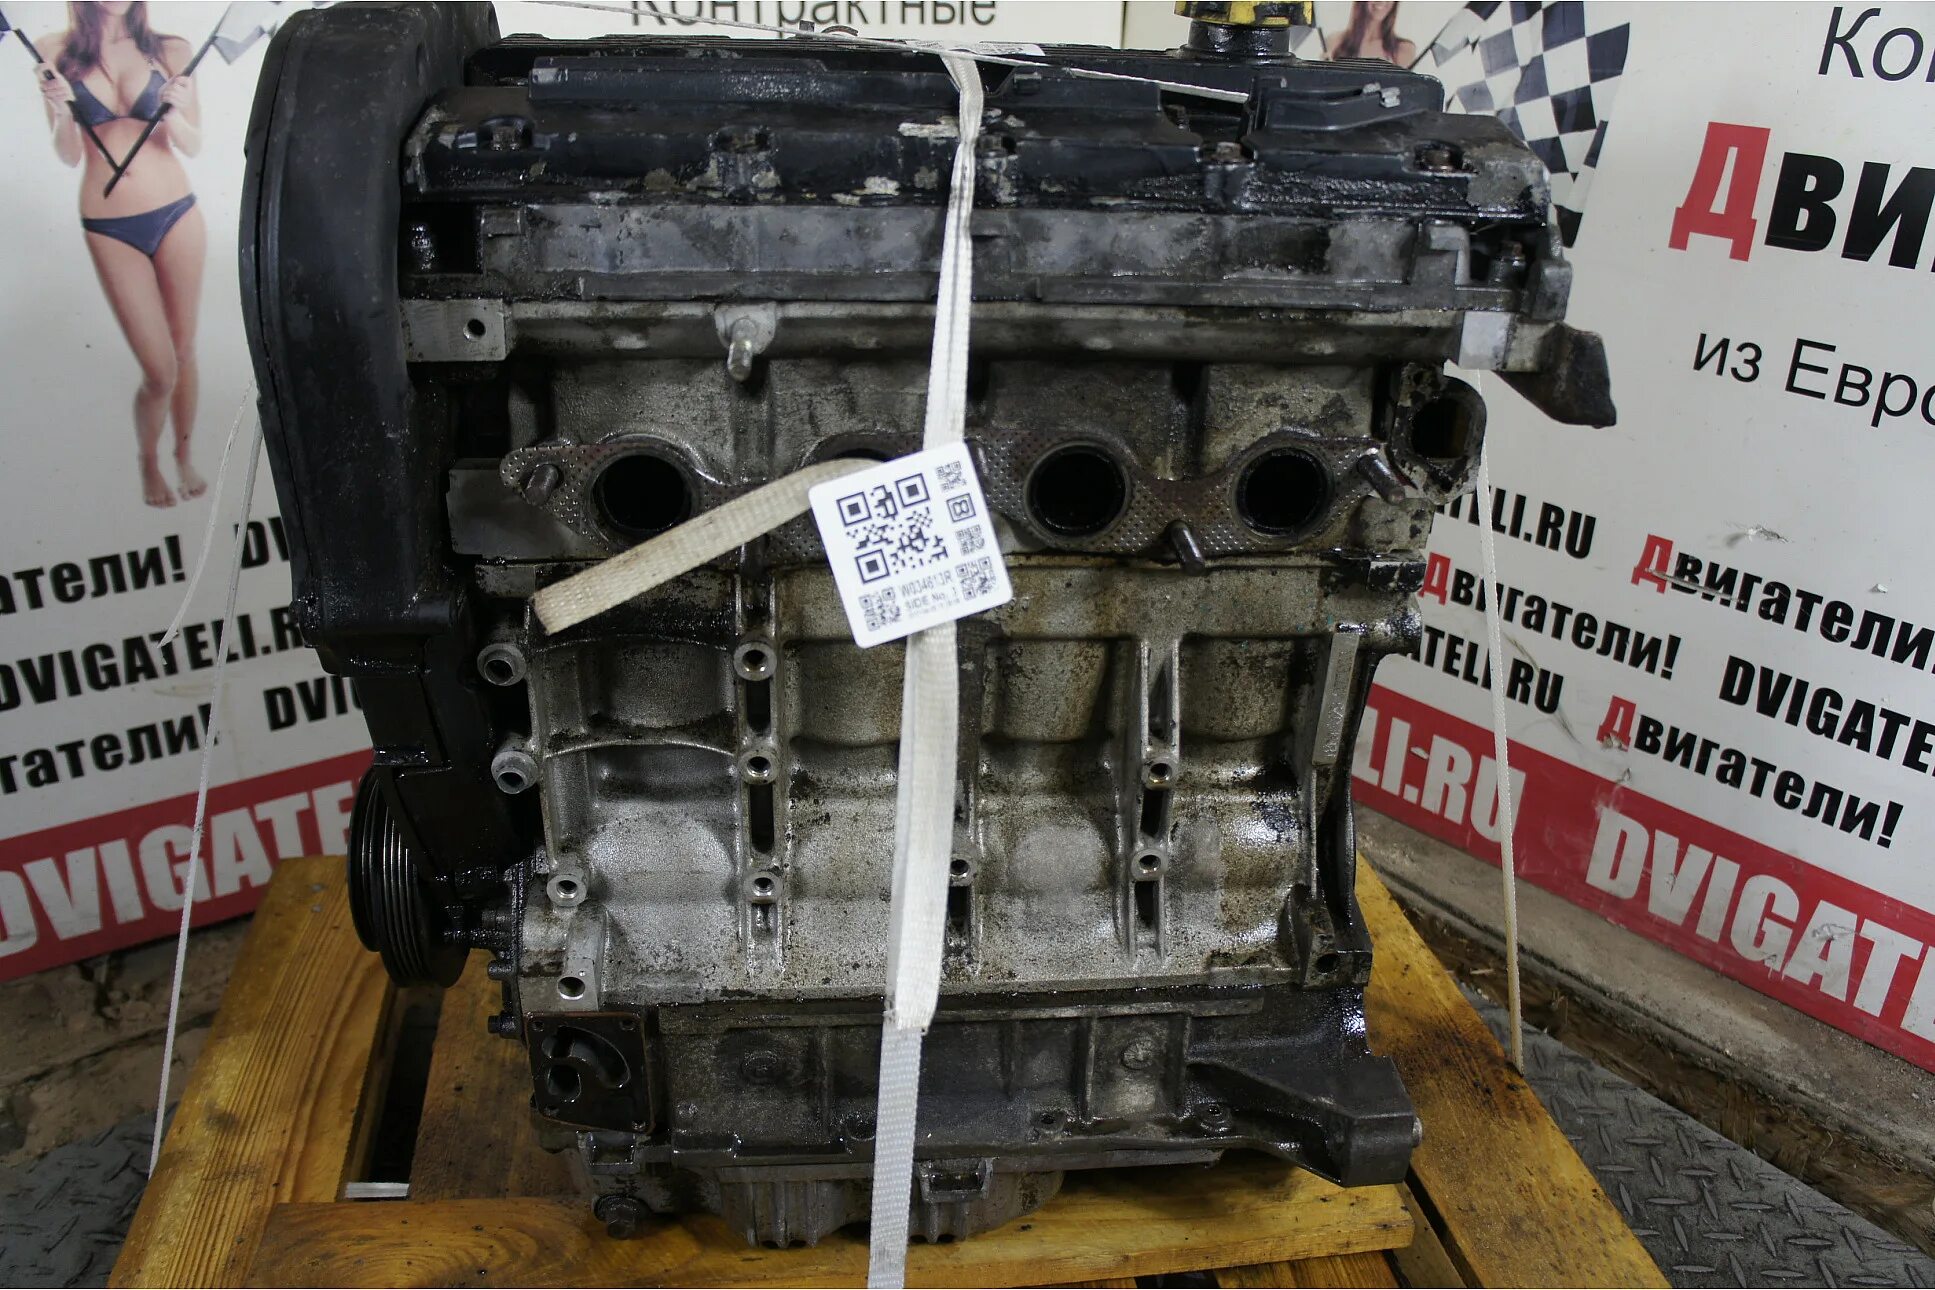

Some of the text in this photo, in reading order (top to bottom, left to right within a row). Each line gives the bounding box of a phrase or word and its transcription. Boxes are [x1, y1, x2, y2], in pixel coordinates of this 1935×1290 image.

[1818, 6, 1935, 83] Ко
[1693, 333, 1762, 384] из
[1417, 551, 1682, 680] Двигатели!
[1631, 534, 1935, 676] Двигатели
[1597, 696, 1904, 849] Двигатели!
